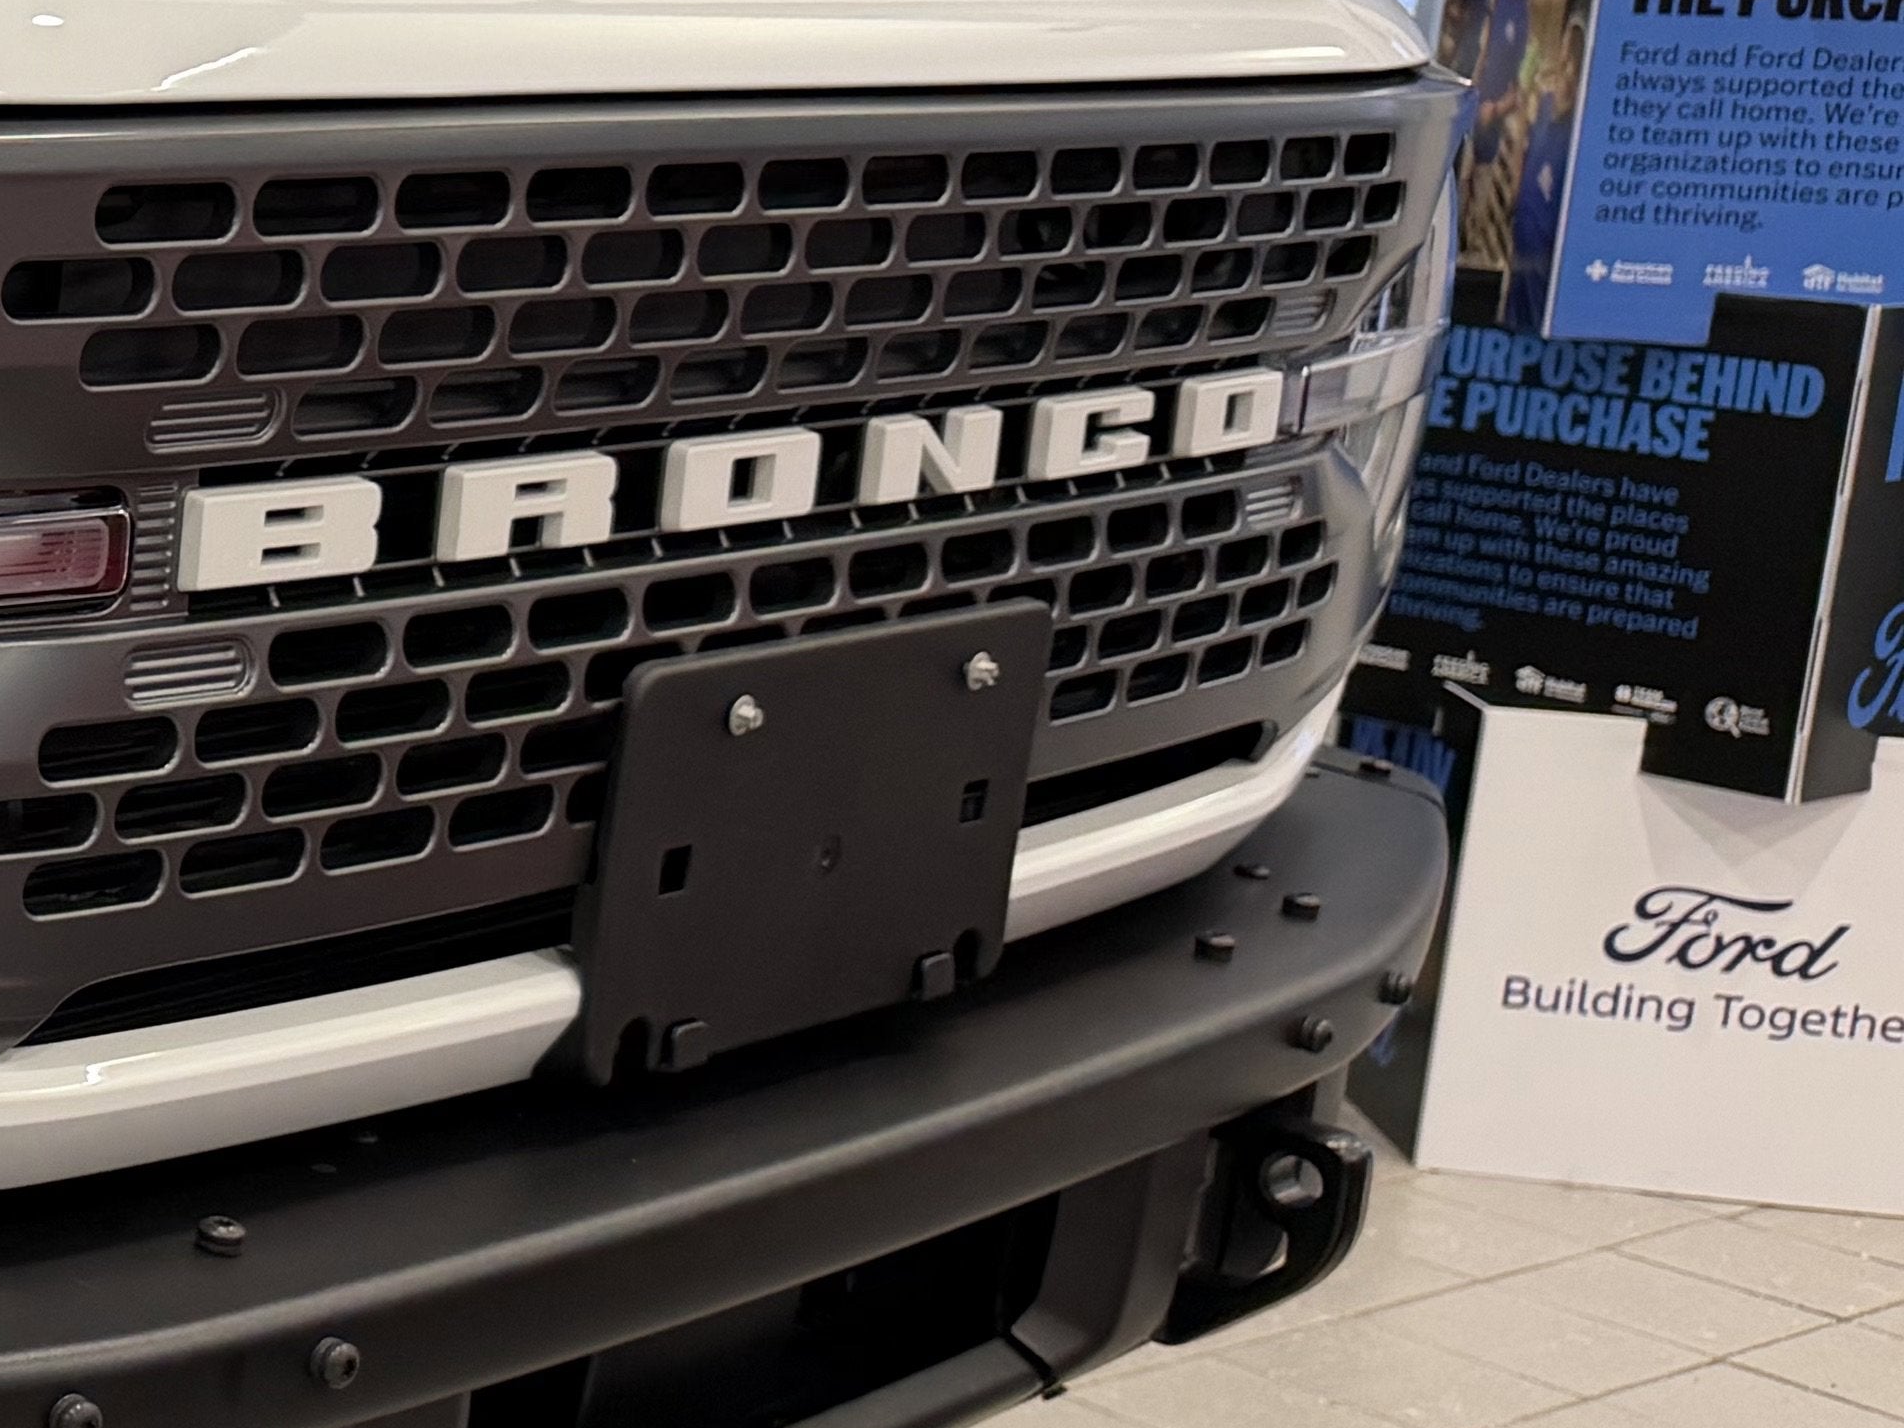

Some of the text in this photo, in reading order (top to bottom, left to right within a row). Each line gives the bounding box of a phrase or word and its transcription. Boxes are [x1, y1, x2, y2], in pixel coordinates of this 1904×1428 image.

[1620, 40, 1904, 74] Ford and Ford Dealer
[1612, 96, 1898, 125] they call home. We're
[1616, 71, 1904, 100] always supported the
[1608, 124, 1898, 153] to team up with these
[1603, 152, 1786, 175] organizations
[1795, 155, 1820, 176] to
[1599, 177, 1642, 197] our
[1651, 180, 1828, 205] communities
[1836, 186, 1879, 206] are
[1595, 203, 1764, 233] and thriving.
[1446, 325, 1825, 419] URPOSE BEHIND
[1461, 381, 1715, 461] PURCHASE
[177, 368, 1281, 593] BRONCO
[1418, 452, 1679, 506] and Ford Dealers have
[1411, 500, 1679, 558] call home. We're proud
[1442, 480, 1562, 514] supported
[1566, 494, 1606, 521] the
[1610, 505, 1690, 534] places
[1444, 530, 1476, 555] up
[1479, 536, 1530, 561] with
[1535, 542, 1600, 571] these
[1605, 556, 1711, 594] amazing
[1508, 563, 1534, 587] to
[1537, 571, 1620, 597] ensure
[1624, 581, 1675, 610] that
[1543, 596, 1583, 620] are
[1586, 604, 1699, 640] prepared
[1603, 886, 1851, 980] Ford
[1501, 976, 1697, 1032] Building
